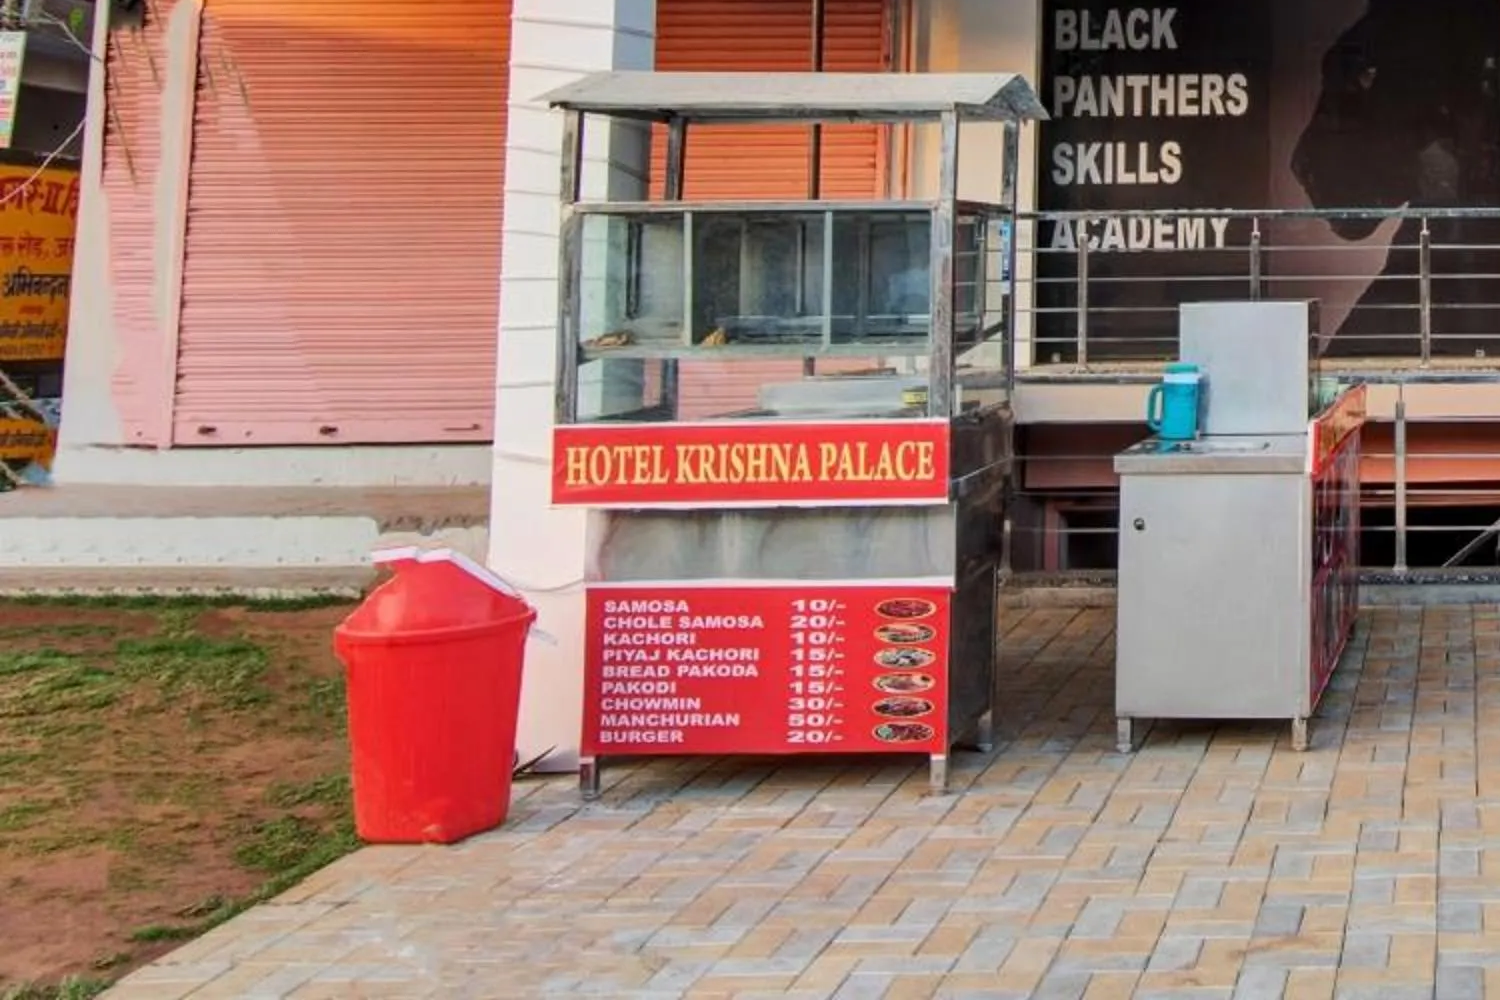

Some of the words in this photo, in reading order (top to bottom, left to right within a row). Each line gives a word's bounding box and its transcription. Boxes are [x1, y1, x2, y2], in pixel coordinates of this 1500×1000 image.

[1055, 7, 1178, 51] BLACK
[1053, 72, 1249, 118] PANTHERS
[1052, 141, 1183, 186] SKILLS
[1051, 209, 1233, 252] ACADEMY
[566, 446, 669, 486] HOTEL
[676, 443, 813, 484] KRISHNA
[819, 440, 935, 482] PALACE
[604, 600, 689, 613] SAMOSA
[791, 599, 846, 612] 10/-
[603, 616, 672, 629] CHOLE
[679, 615, 764, 629] SAMOSA
[790, 615, 845, 629] 20/-
[603, 632, 697, 645] KACHORI
[790, 631, 845, 645] 10/-
[603, 648, 660, 662] PIYAJ
[667, 648, 760, 661] KACHORI
[790, 648, 845, 661] 15/-
[602, 665, 671, 678] BREAD
[677, 664, 759, 677] PAKODA
[789, 664, 844, 678] 15/-
[601, 681, 677, 694] PAKODI
[789, 681, 844, 695] 15/-
[601, 697, 701, 711] CHOWMIN
[788, 697, 844, 710] 30/-
[601, 713, 740, 727] MANCHURIAN
[788, 713, 843, 727] 50/-
[600, 730, 684, 743] BURGER
[787, 730, 843, 743] 20/-
